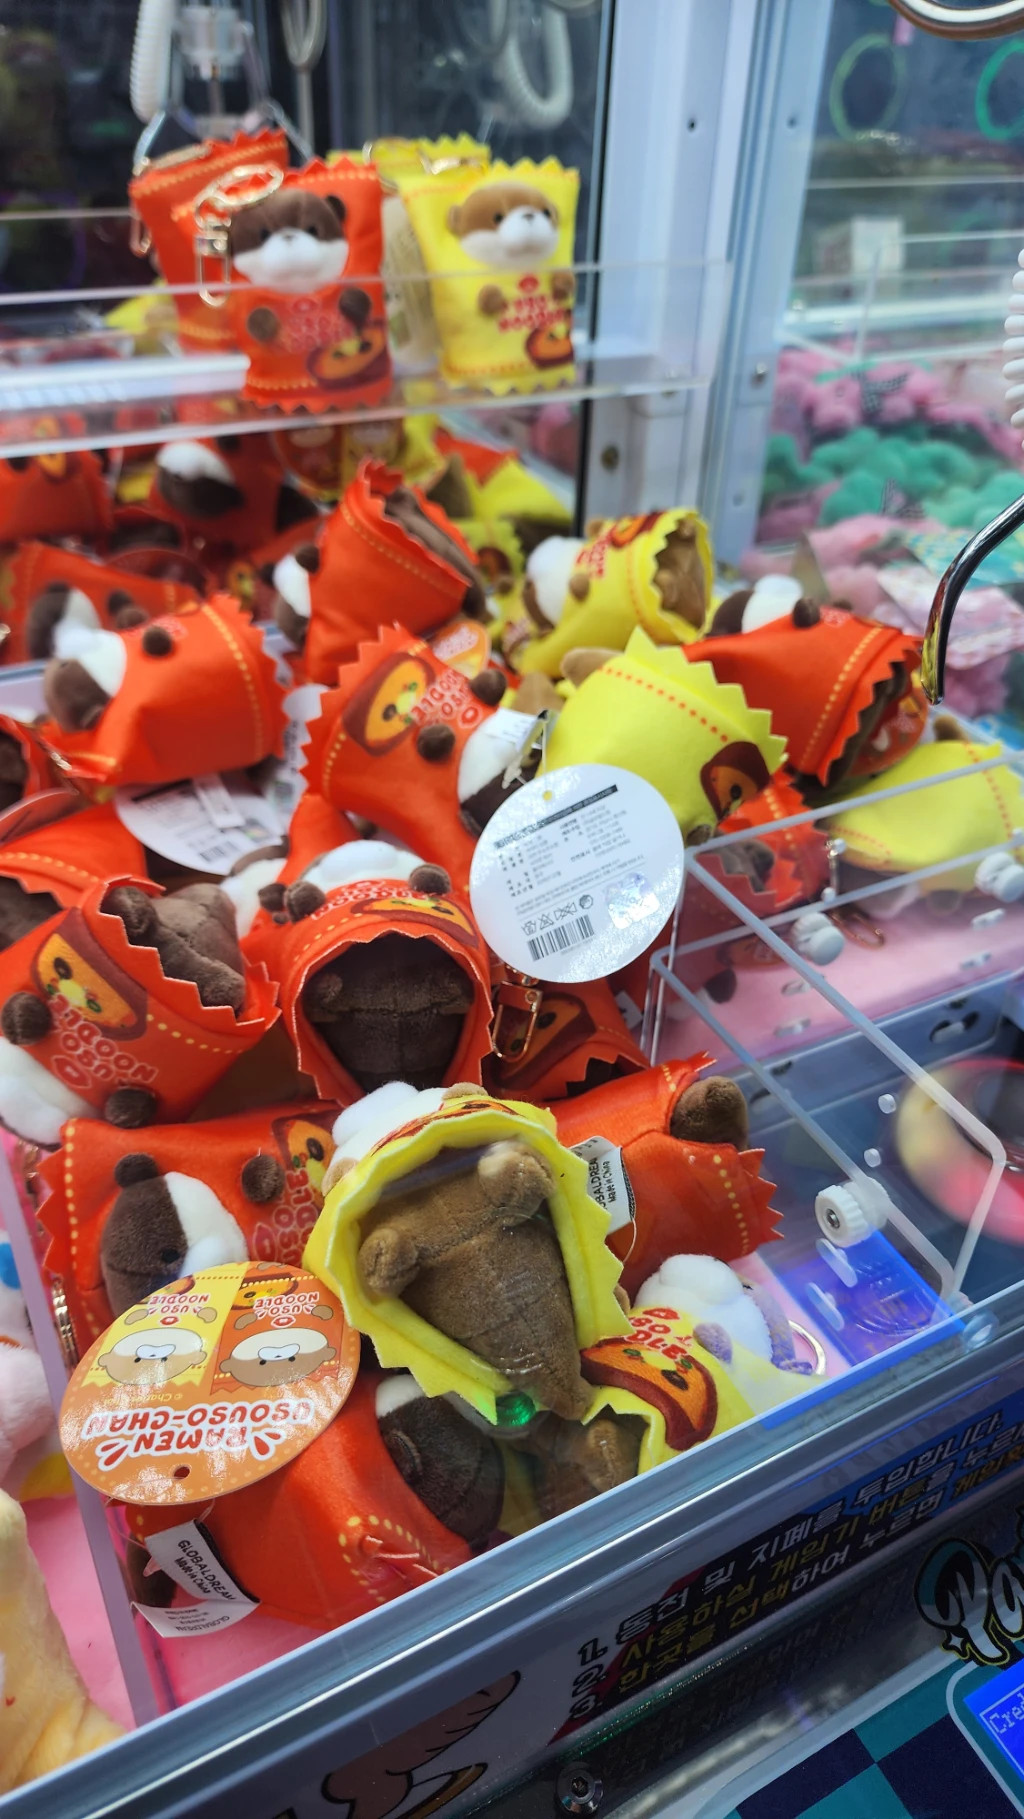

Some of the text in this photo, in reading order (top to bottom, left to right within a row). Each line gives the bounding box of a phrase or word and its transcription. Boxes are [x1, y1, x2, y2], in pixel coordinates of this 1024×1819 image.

[48, 993, 159, 1084] NOODLE
[60, 1031, 116, 1081] USO
[149, 1293, 210, 1305] NOODLE
[160, 1305, 190, 1315] USO
[255, 1292, 319, 1308] NOODLE
[270, 1304, 301, 1316] USO
[86, 1402, 311, 1435] USOUSO-CHAN
[134, 1426, 247, 1453] RAMEN
[577, 1409, 1003, 1666] 1. 동전 및 지폐를 투입합니다.
[729, 1545, 850, 1628] 선택하여
[860, 1490, 944, 1549] 누르면
[572, 1664, 608, 1697] 2.
[621, 1576, 755, 1668] 사용하실
[770, 1517, 860, 1582] 게임기
